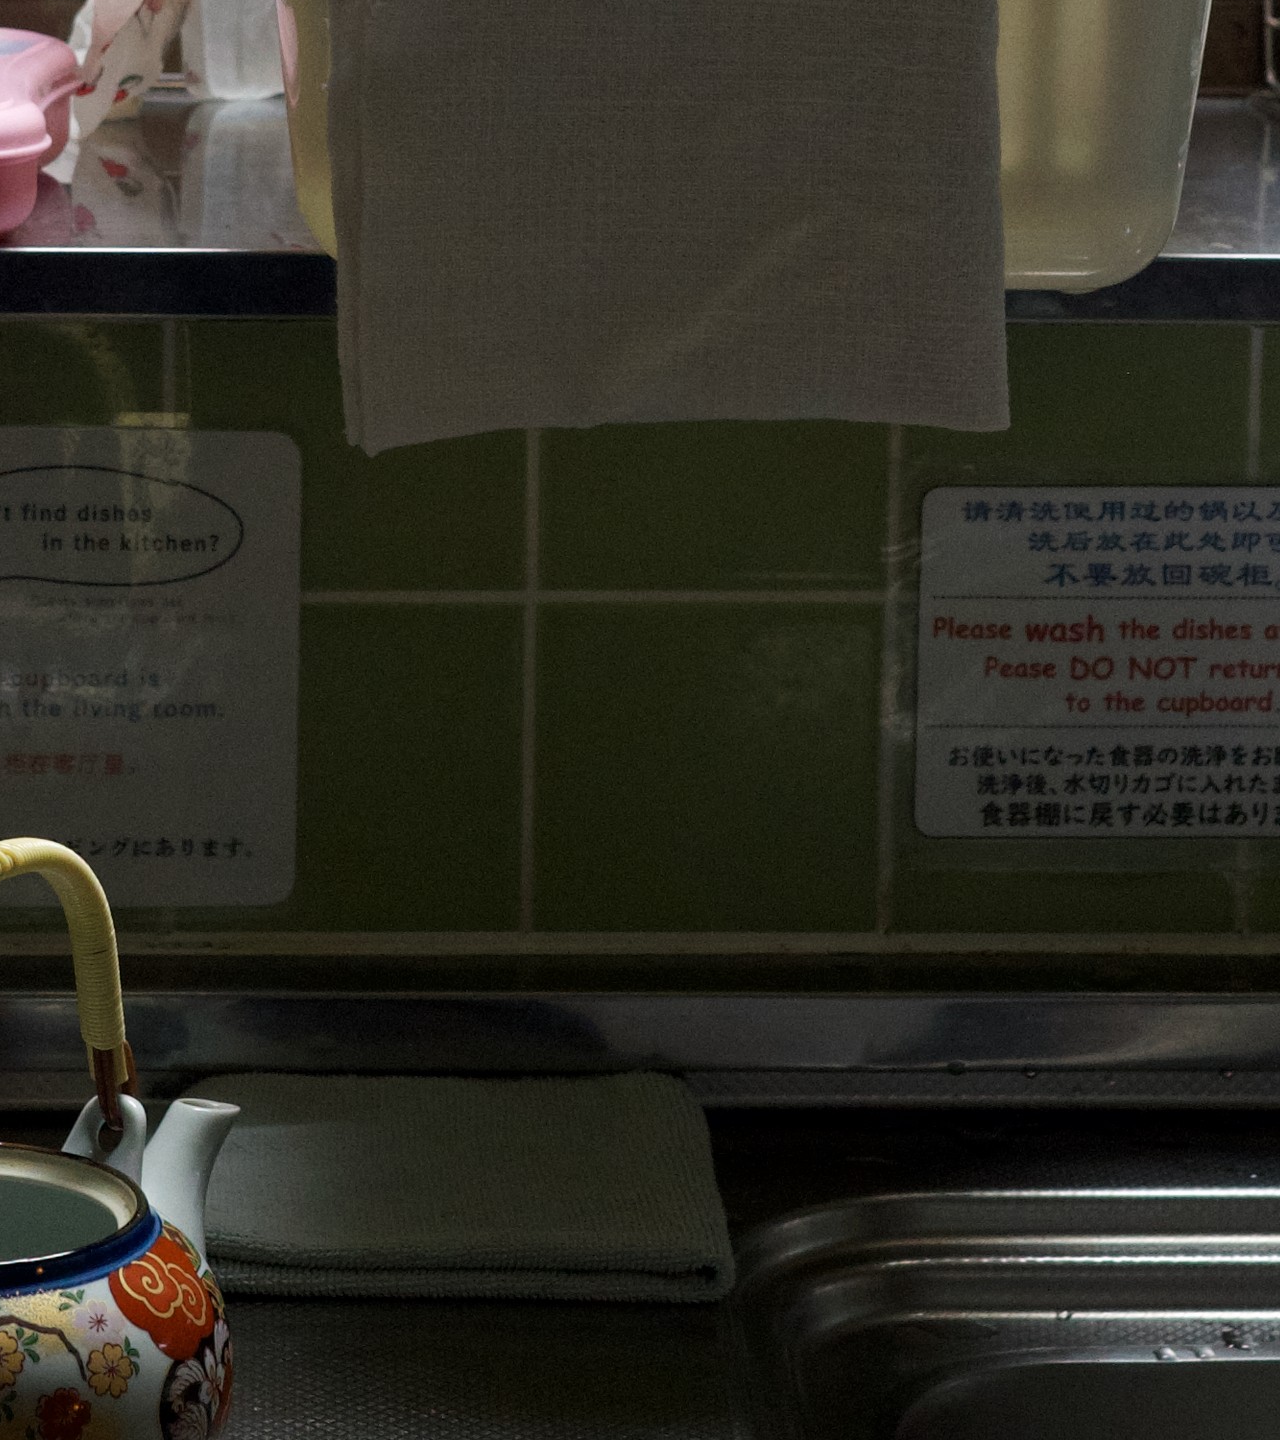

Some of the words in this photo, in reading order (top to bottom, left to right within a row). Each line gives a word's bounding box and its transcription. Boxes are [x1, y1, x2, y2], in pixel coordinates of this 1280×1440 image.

[22, 504, 67, 522] find
[77, 504, 152, 523] dishes
[42, 535, 63, 552] in
[73, 535, 110, 552] the
[120, 534, 219, 553] kitchen?
[932, 616, 1012, 641] Please
[1026, 615, 1105, 644] wash
[1118, 619, 1159, 641] the
[1172, 618, 1252, 642] dishes
[141, 668, 160, 687] is
[984, 659, 1058, 680] Pease
[1069, 657, 1115, 681] DO
[1128, 656, 1198, 680] NOT
[22, 697, 62, 718] the
[72, 697, 142, 722] living
[152, 701, 225, 719] room.
[1065, 693, 1090, 713] to
[1104, 691, 1146, 713] the
[1156, 690, 1280, 718] cupboard.
